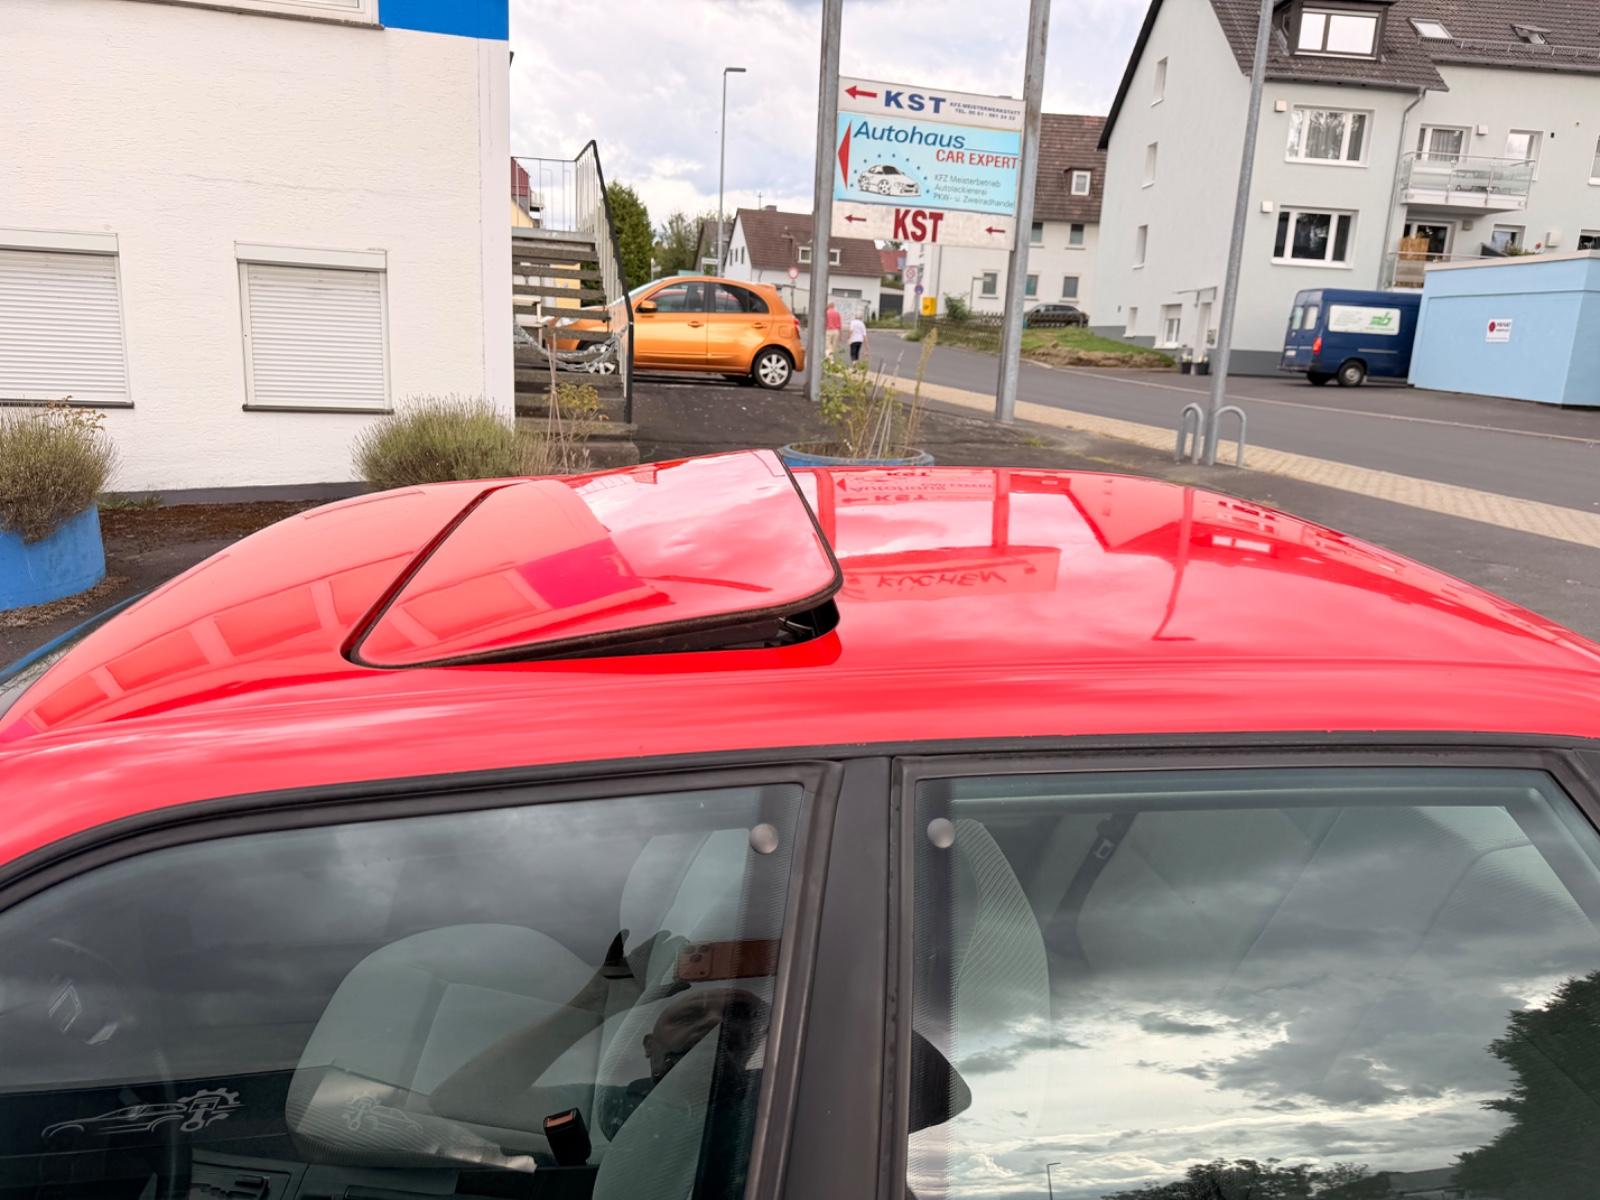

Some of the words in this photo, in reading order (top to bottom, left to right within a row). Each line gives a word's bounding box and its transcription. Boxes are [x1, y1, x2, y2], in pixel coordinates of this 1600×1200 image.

[884, 90, 947, 114] KST
[853, 121, 966, 149] Autohaus
[936, 149, 965, 164] CAR
[969, 153, 1018, 170] EXPERT
[934, 184, 988, 196] Autolackiererei
[950, 175, 1001, 188] Meisterbetrieb
[893, 208, 944, 243] KST
